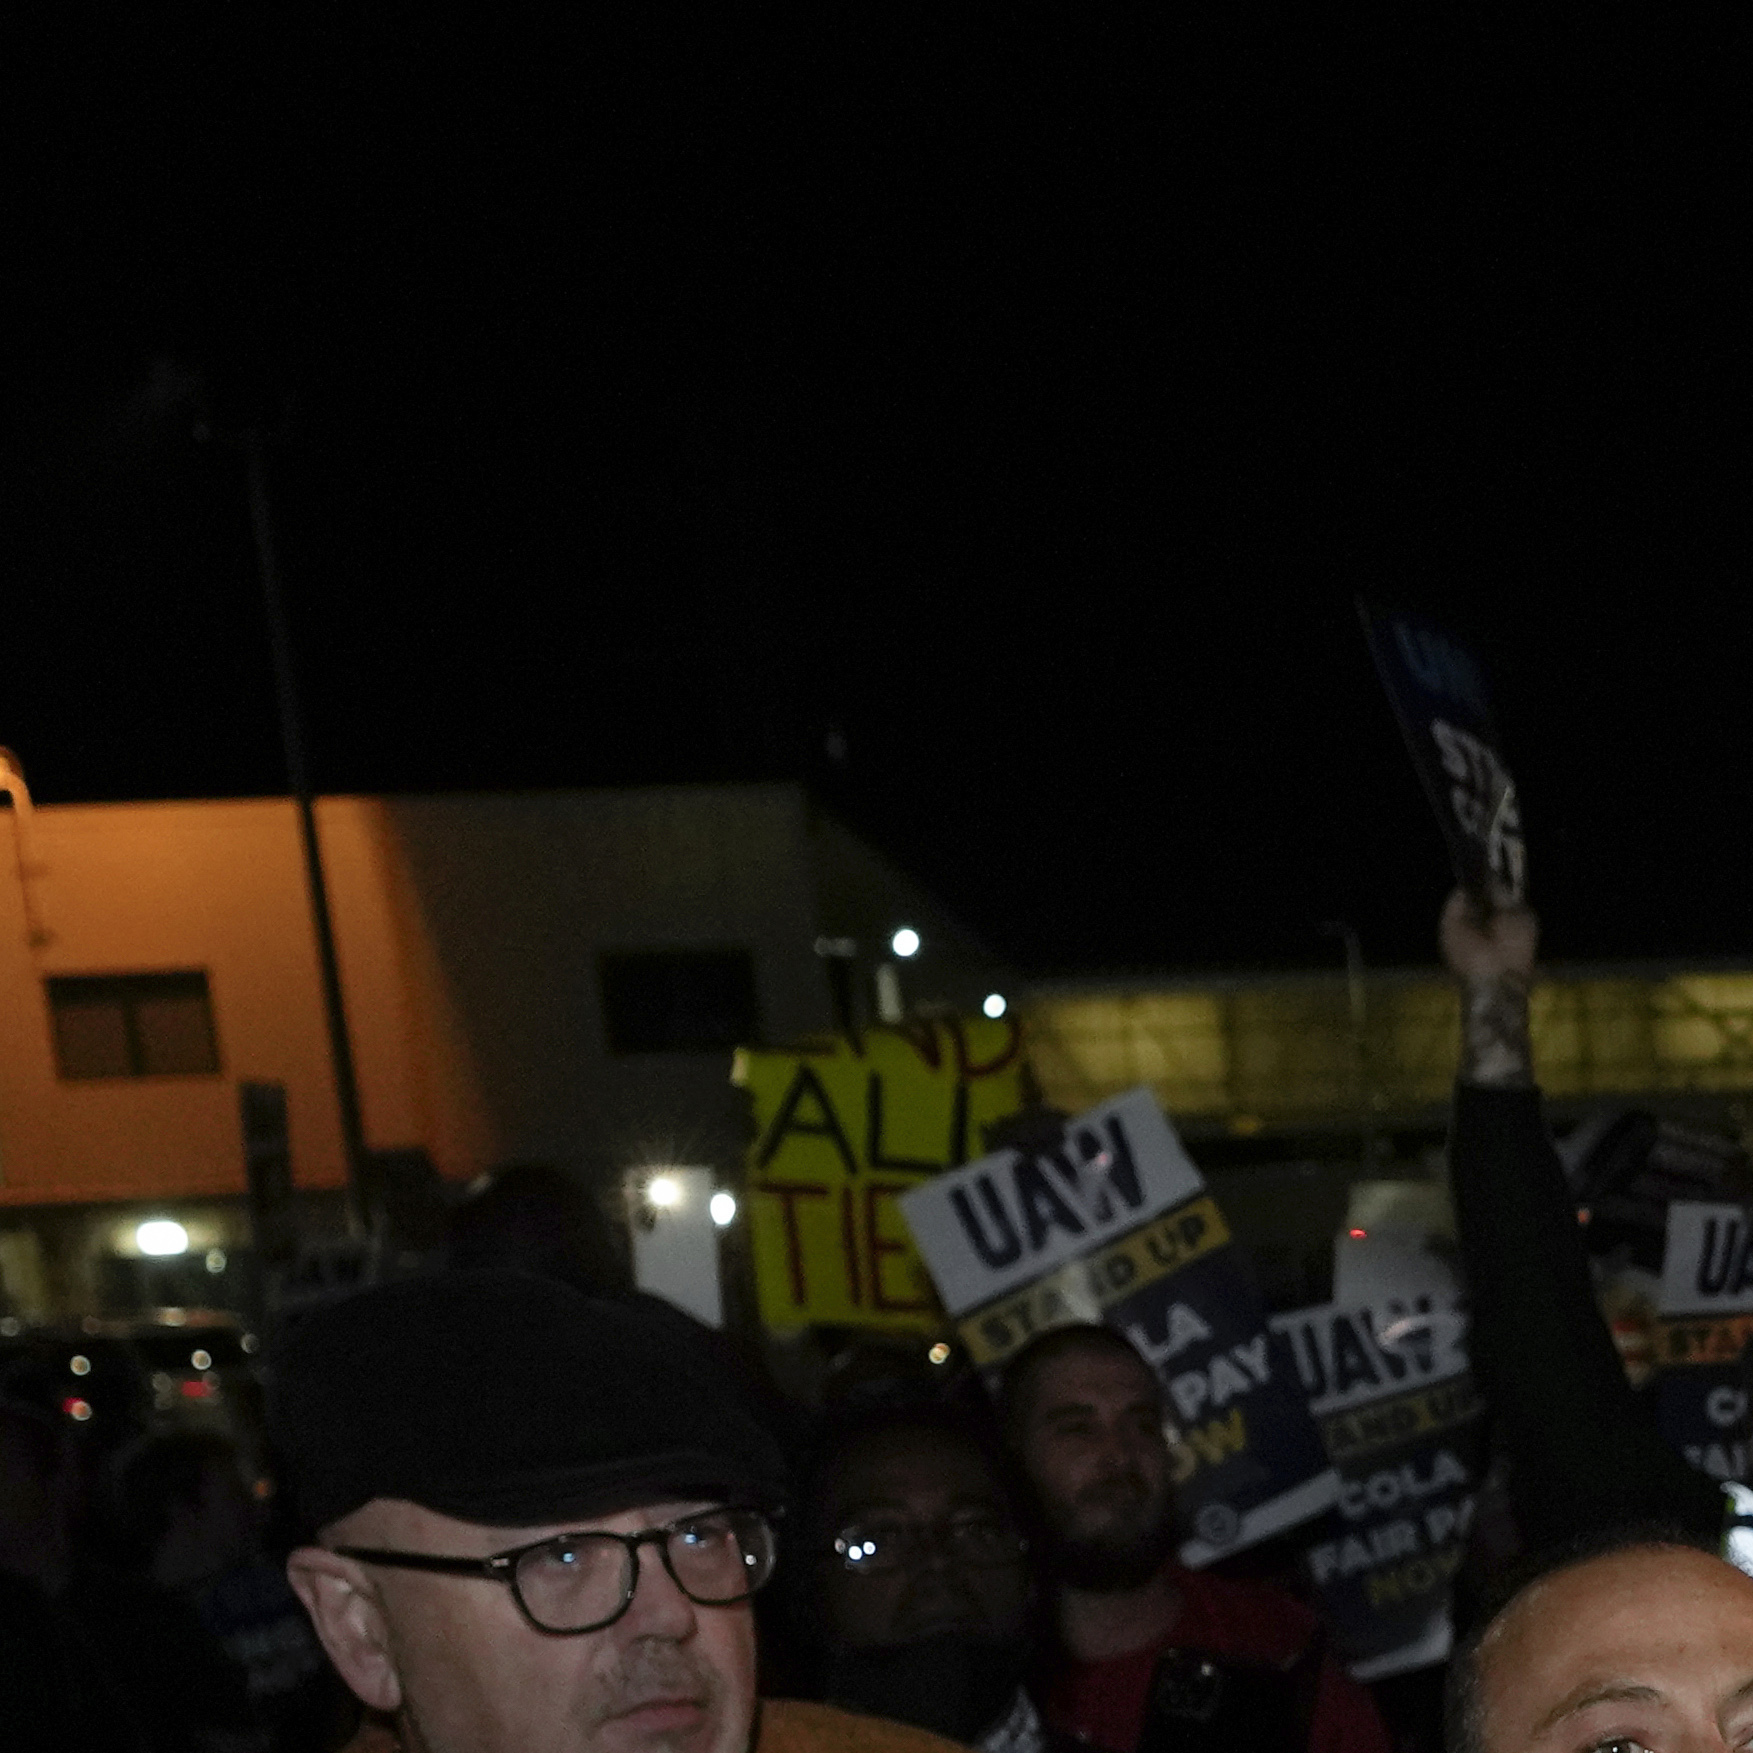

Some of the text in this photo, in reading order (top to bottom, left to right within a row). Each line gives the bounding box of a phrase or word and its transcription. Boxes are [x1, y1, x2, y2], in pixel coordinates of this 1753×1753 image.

[949, 1114, 1144, 1271] UAW
[1168, 1333, 1271, 1421] PAY
[1338, 1450, 1467, 1521] COLA
